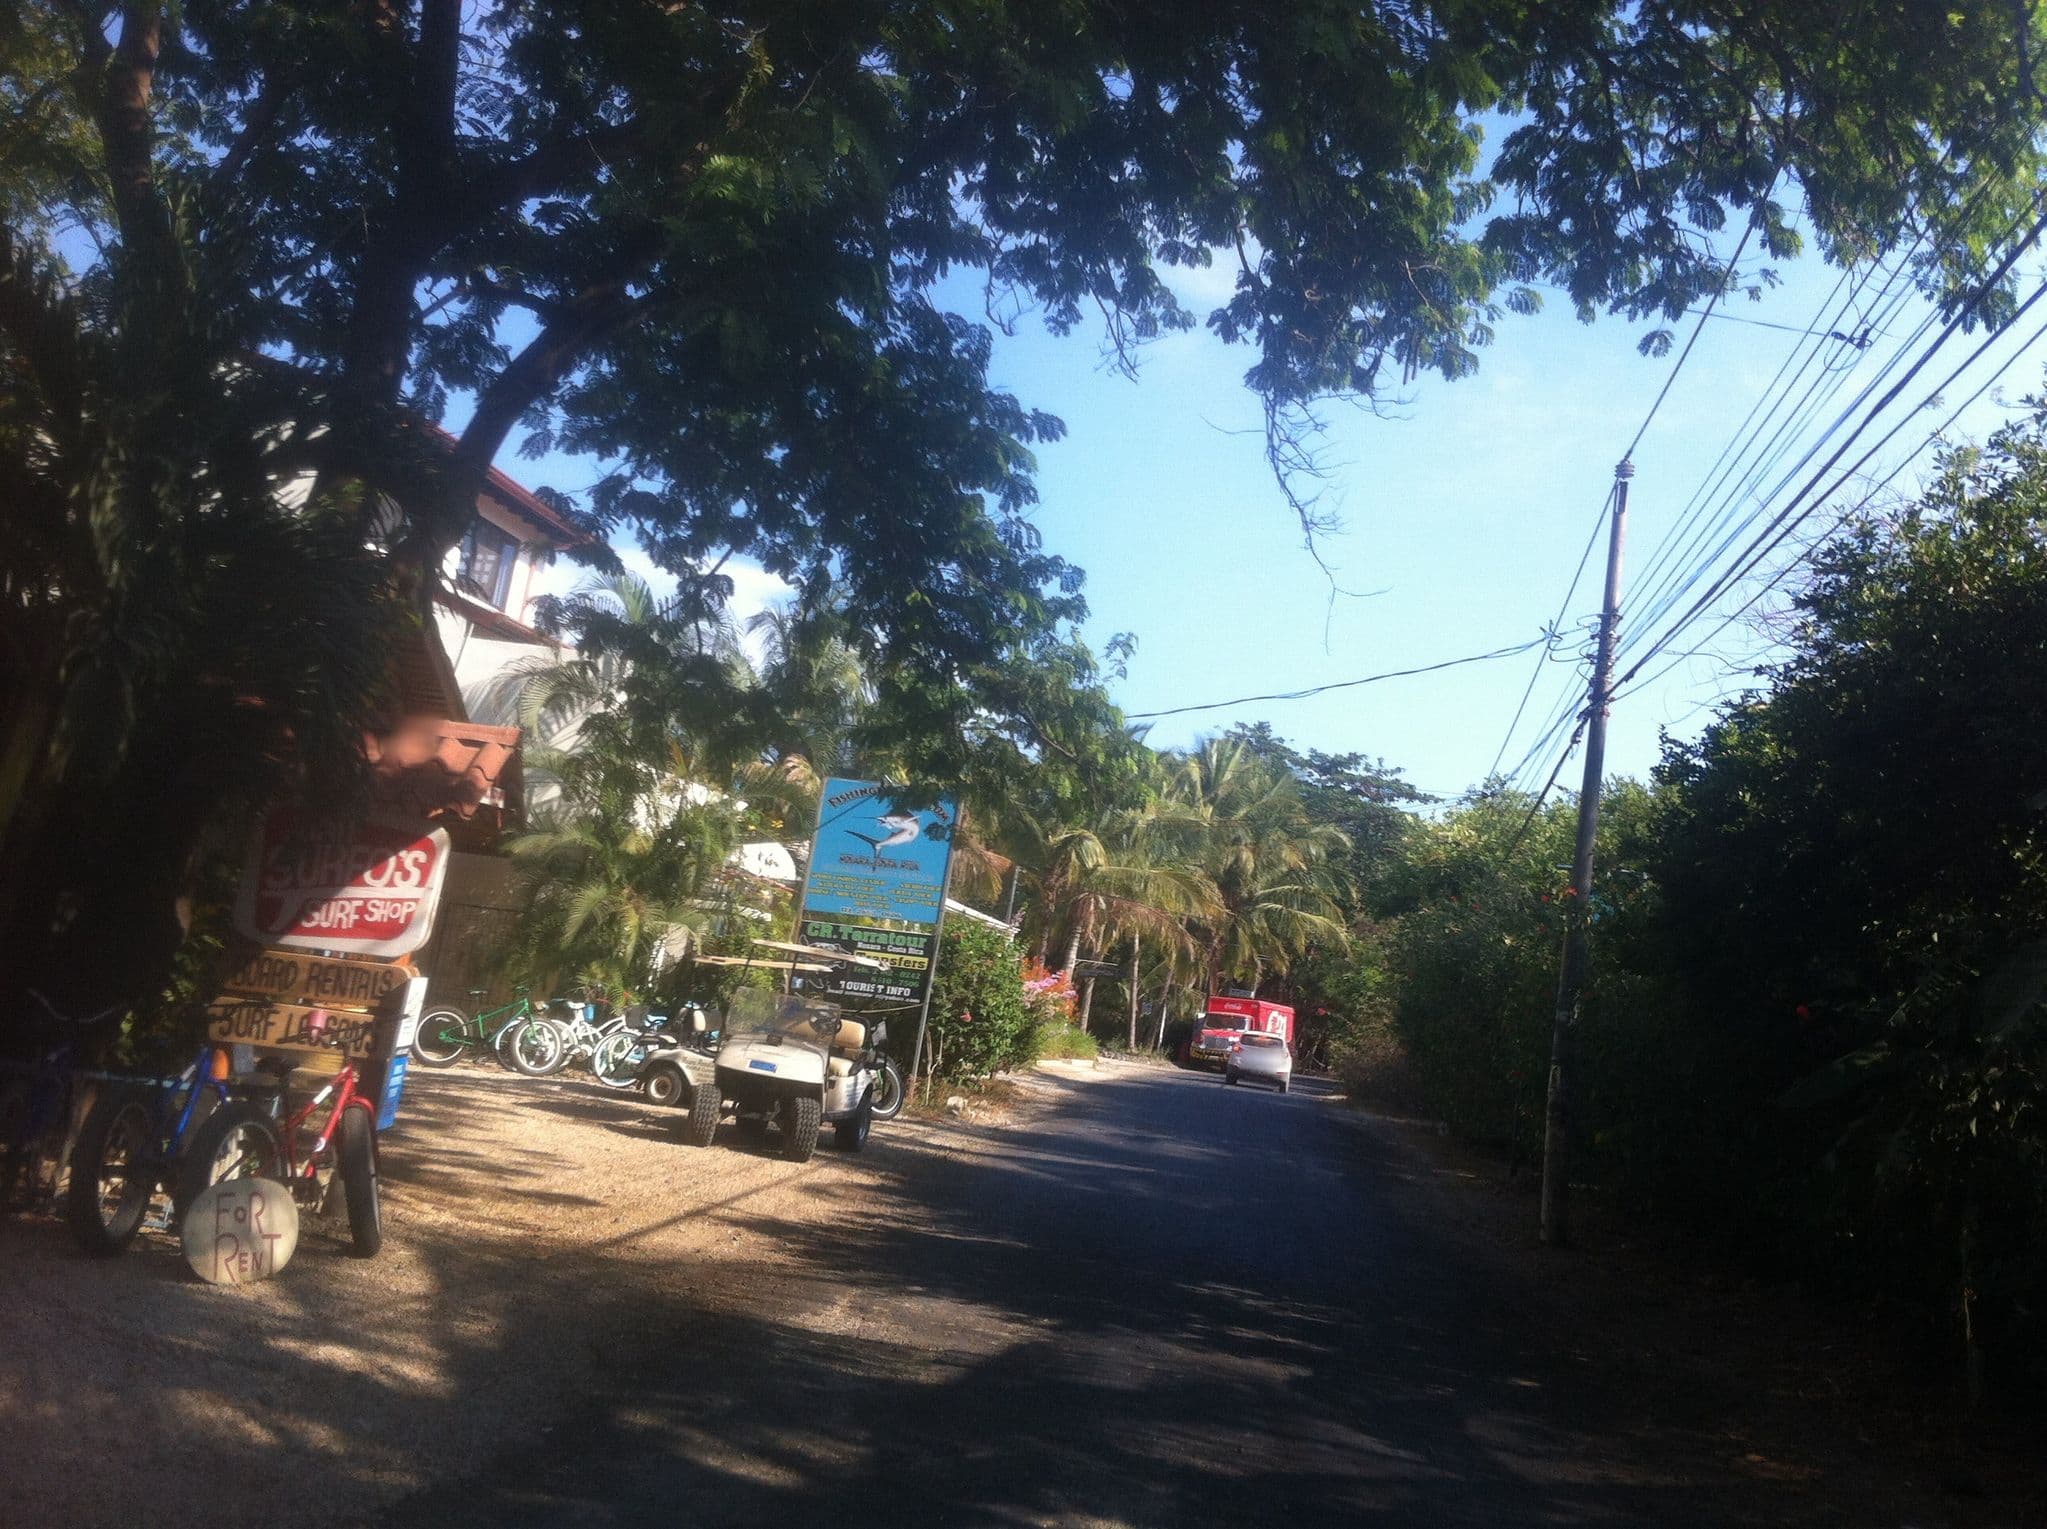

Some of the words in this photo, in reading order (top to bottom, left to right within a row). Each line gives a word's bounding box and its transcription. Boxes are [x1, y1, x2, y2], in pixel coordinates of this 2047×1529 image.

[301, 898, 363, 929] SURF
[364, 899, 417, 924] SHOP
[856, 951, 927, 969] Tansfers
[304, 961, 392, 999] RENTALS
[886, 984, 912, 996] INFO
[218, 1003, 280, 1042] SURF
[215, 1190, 265, 1235] FOR
[214, 1232, 282, 1282] RENT
